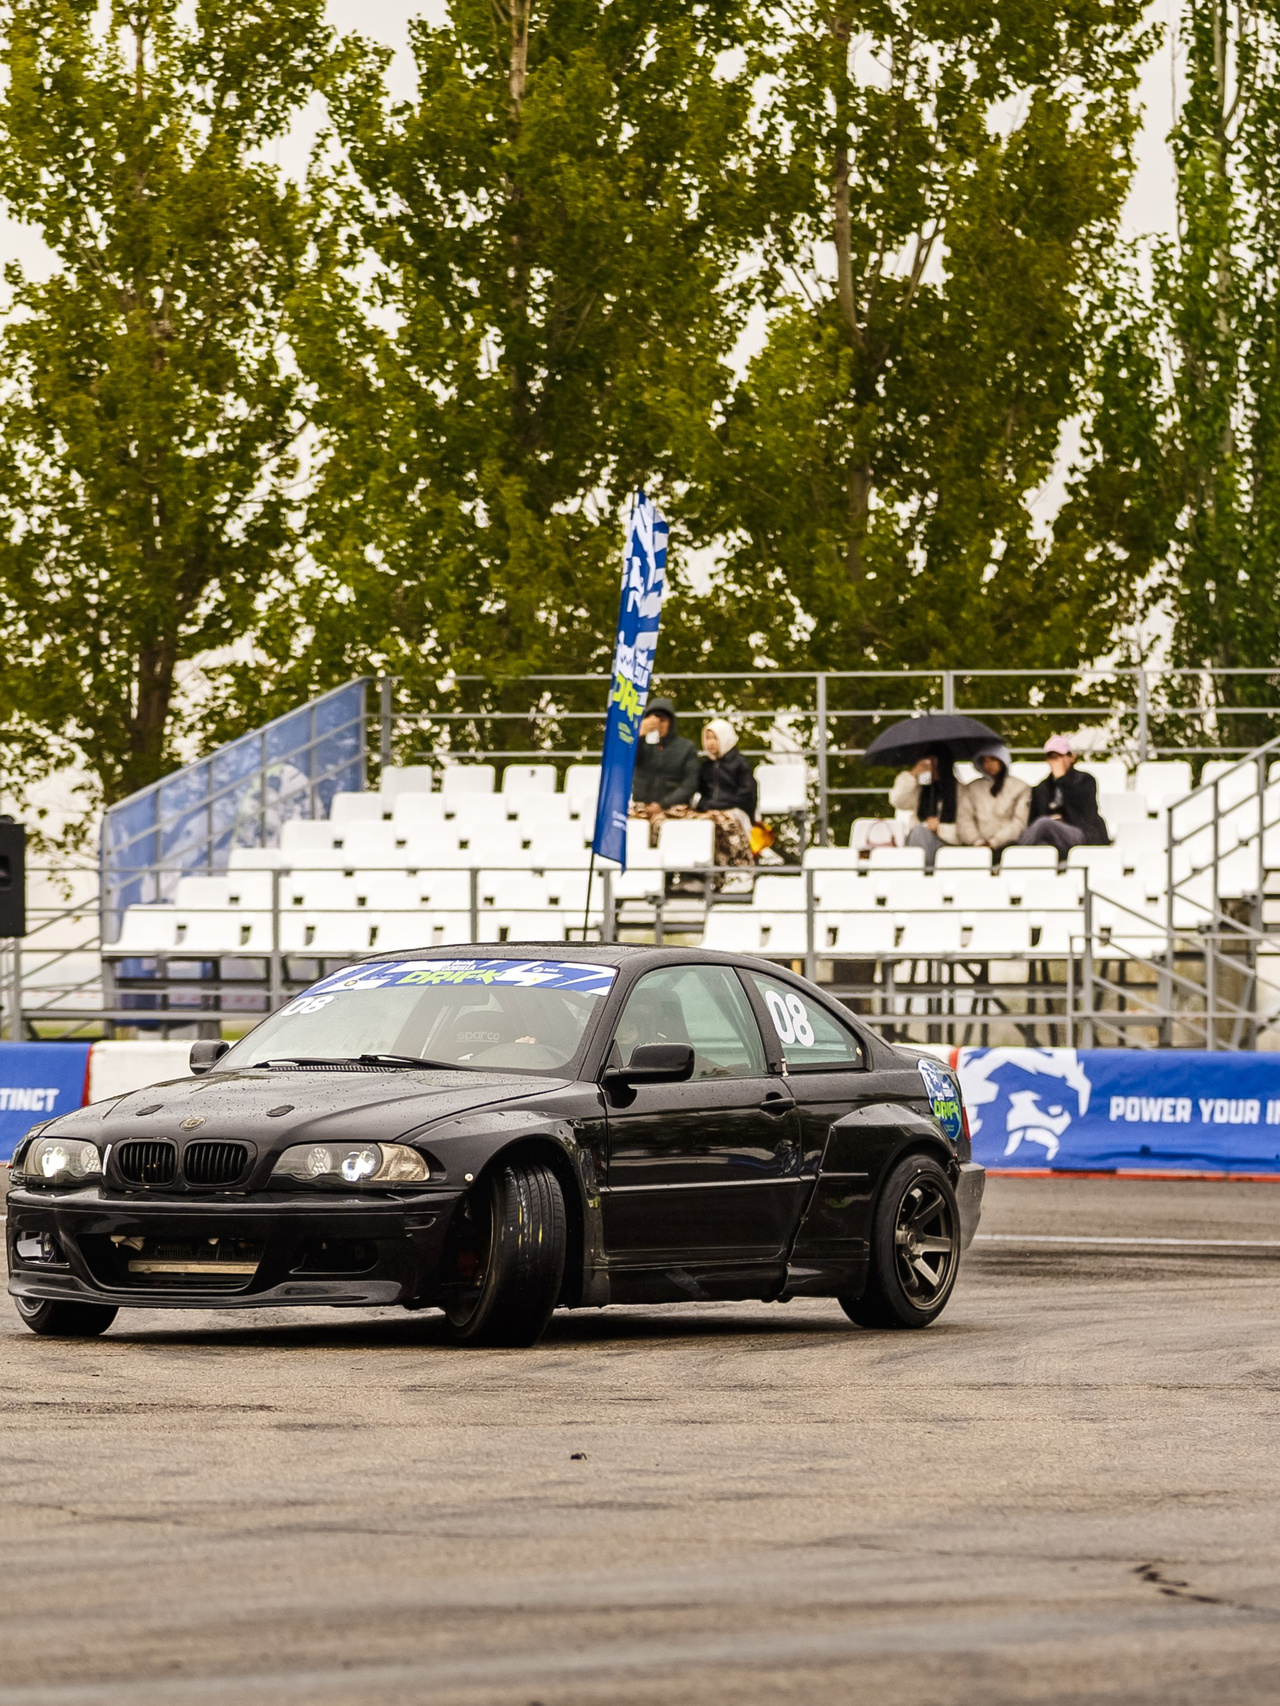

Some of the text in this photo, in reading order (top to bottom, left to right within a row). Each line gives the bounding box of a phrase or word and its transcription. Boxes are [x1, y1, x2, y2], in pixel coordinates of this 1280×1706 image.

[280, 995, 335, 1017] 08
[765, 990, 815, 1047] 08
[456, 1031, 500, 1042] sparco
[1109, 1096, 1193, 1123] POWER
[1198, 1097, 1261, 1125] YOUR
